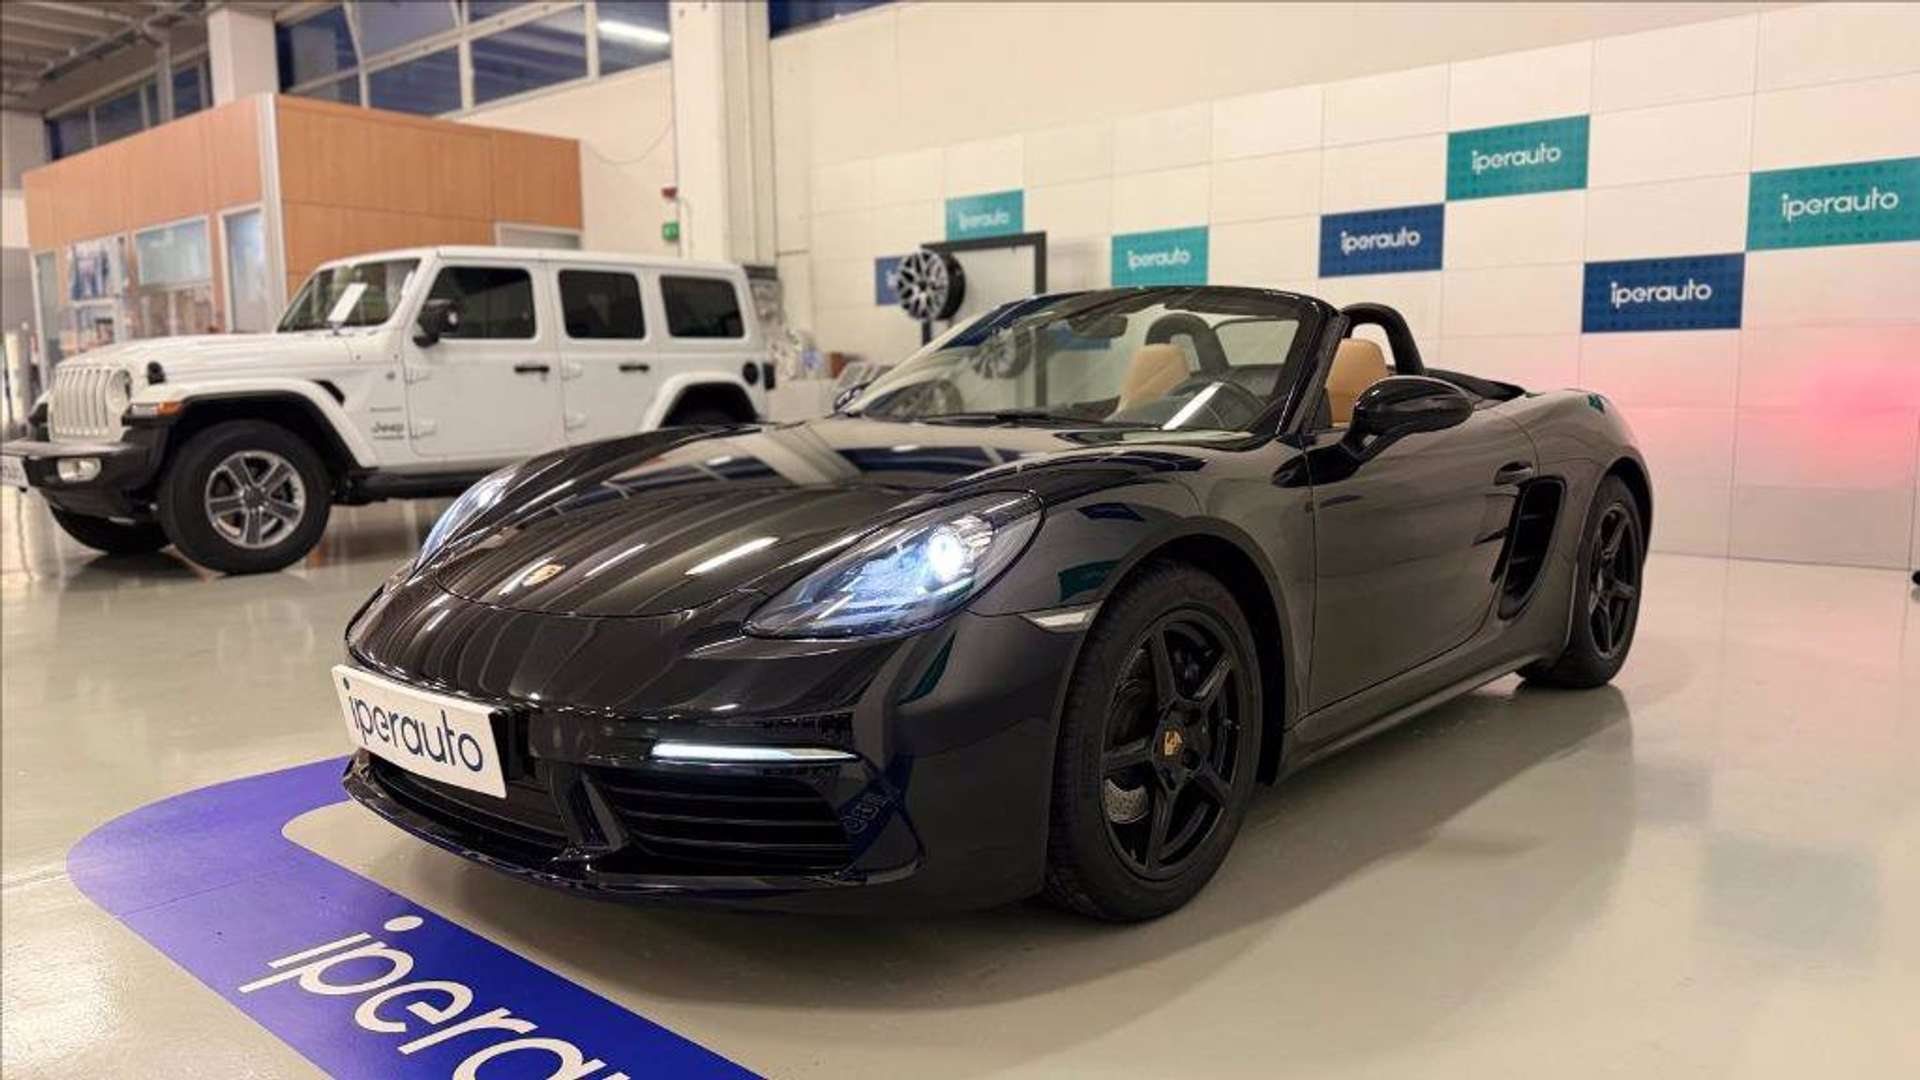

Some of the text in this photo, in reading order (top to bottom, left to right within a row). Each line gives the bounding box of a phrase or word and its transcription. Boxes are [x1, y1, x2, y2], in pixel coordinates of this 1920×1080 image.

[1473, 142, 1562, 174] iperauto
[1782, 187, 1898, 221] iperauto
[1340, 226, 1421, 255] iperauto
[1127, 247, 1191, 271] iperauto
[1610, 279, 1713, 309] iperauto
[343, 677, 483, 773] iperauto
[238, 915, 630, 1080] ipera
